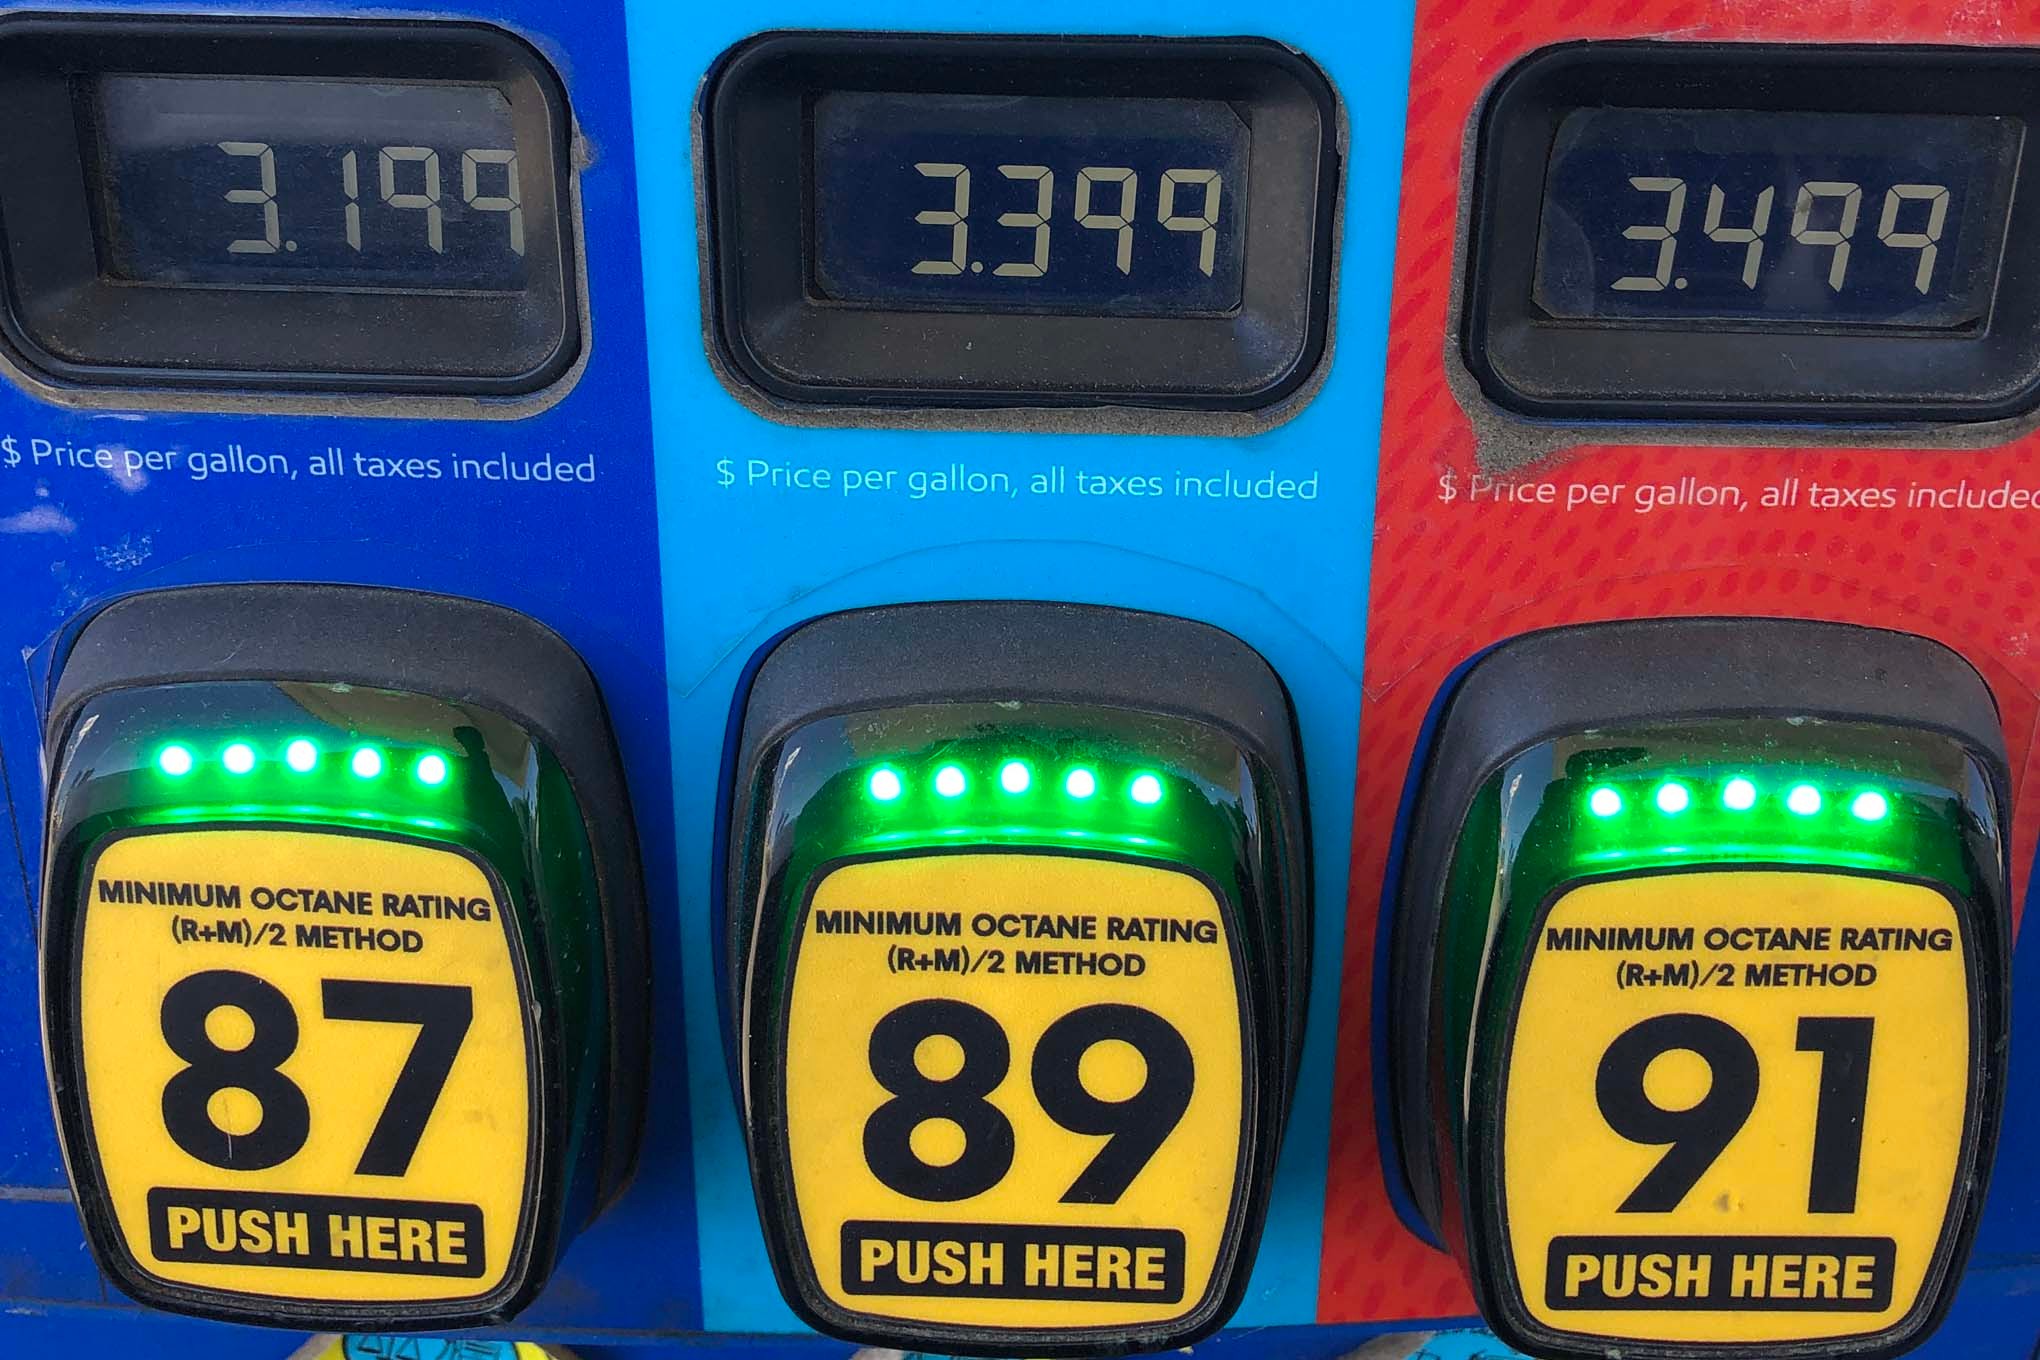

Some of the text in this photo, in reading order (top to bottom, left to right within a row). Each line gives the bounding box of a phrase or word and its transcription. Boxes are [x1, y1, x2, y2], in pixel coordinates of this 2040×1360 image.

[217, 141, 526, 257] 3.199
[911, 162, 1223, 278] 3.399
[1610, 176, 1951, 295] 3.499
[2, 435, 597, 484] $ Price per gallon, all taxes included
[715, 457, 1319, 501] $ Price per gallon, all taxes included
[1438, 465, 1458, 505] $
[1470, 474, 1557, 504] Price
[1566, 483, 1626, 512] per
[1634, 477, 1750, 513] gallon,
[1759, 477, 1800, 508] all
[1807, 480, 1897, 509] taxes
[98, 879, 492, 922] MINIMUM OCTANE RATING
[171, 916, 425, 954] (R+M)/2 METHOD
[815, 910, 1218, 944] MINIMUM OCTANE RATING
[1545, 926, 1954, 952] MINIMUM OCTANE RATING
[887, 945, 1147, 978] (R+M)/2 METHOD
[1616, 960, 1878, 991] (R+M)/2 METHOD
[160, 969, 474, 1178] 87
[862, 998, 1196, 1205] 89
[1594, 1012, 1876, 1215] 91
[166, 1206, 468, 1265] PUSH HERE
[859, 1239, 1166, 1291] PUSH HERE
[1564, 1254, 1876, 1300] PUSH HERE
